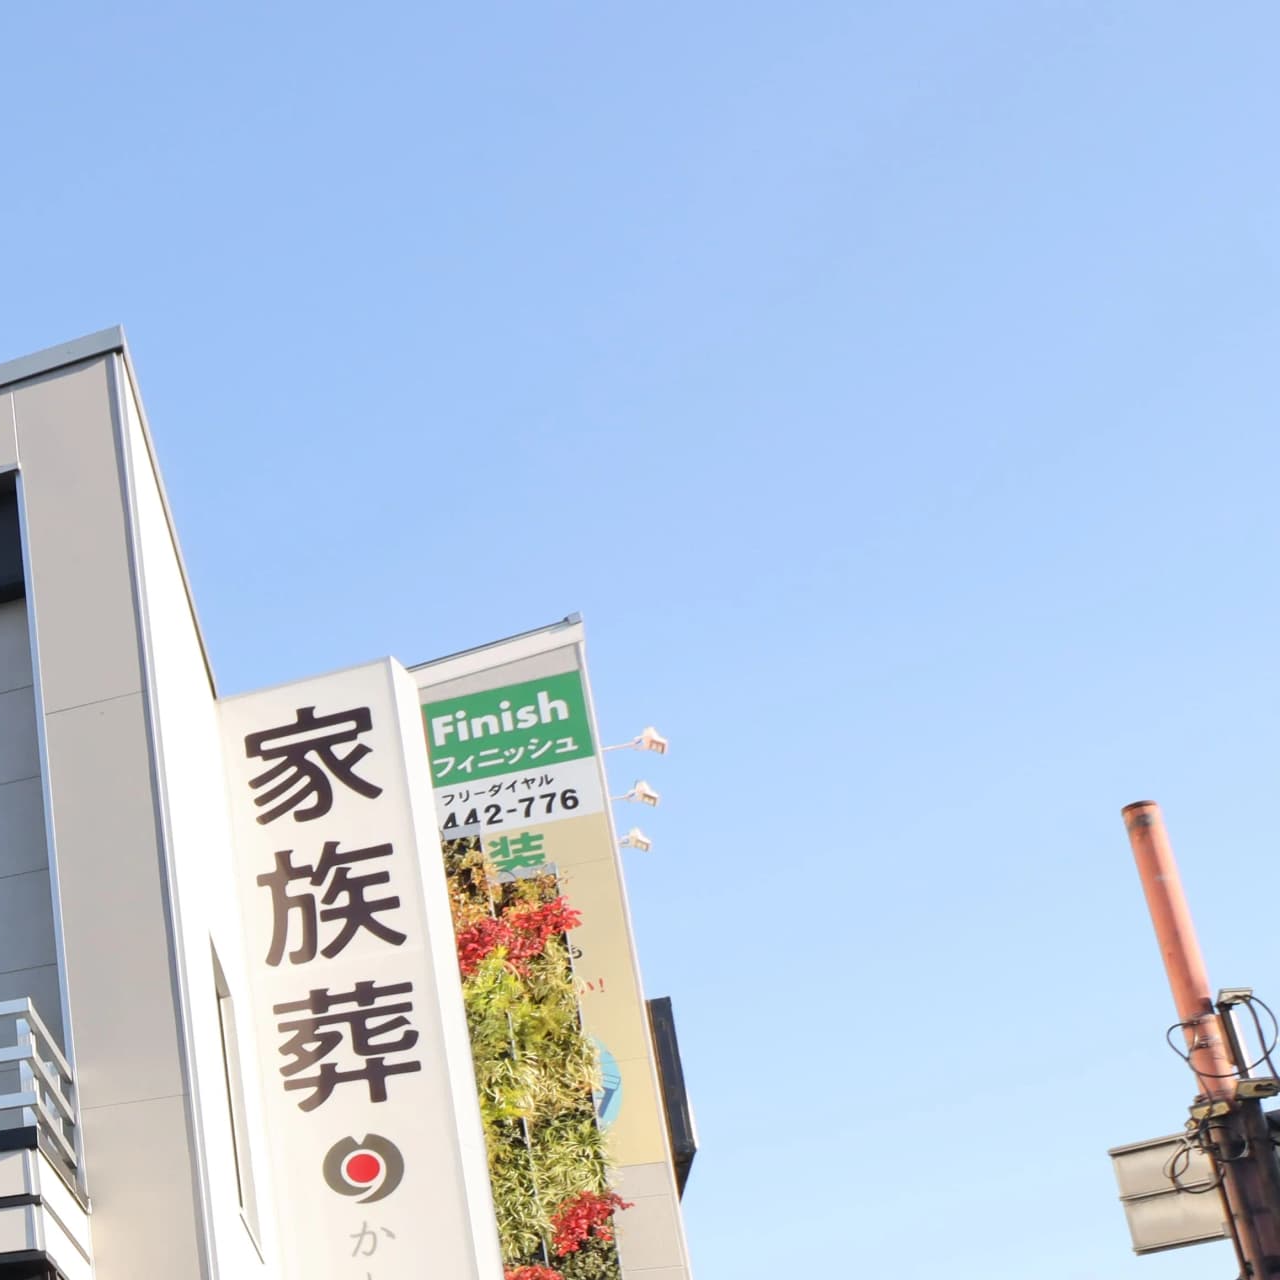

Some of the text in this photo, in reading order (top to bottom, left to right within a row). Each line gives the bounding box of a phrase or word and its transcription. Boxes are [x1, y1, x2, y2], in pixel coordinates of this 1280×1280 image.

[431, 690, 569, 747] Finish
[432, 737, 578, 779] フィニッシュ
[244, 706, 422, 1113] 家族葬
